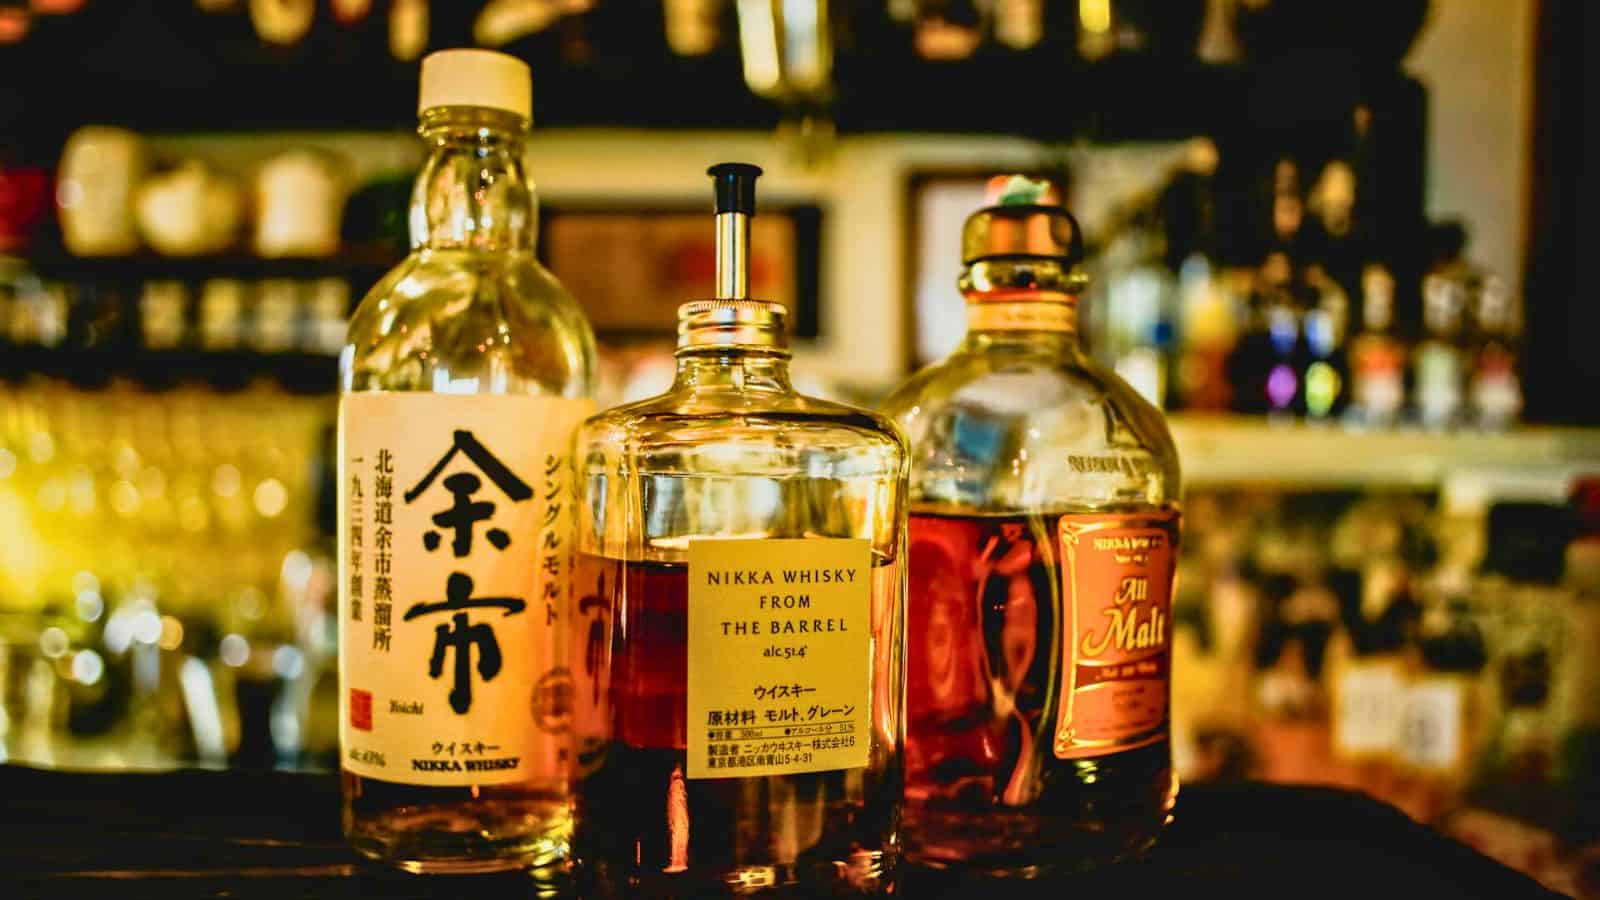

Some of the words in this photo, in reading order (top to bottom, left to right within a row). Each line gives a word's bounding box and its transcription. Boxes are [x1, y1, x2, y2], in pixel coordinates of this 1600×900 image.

[543, 455, 562, 626] シングルモルト
[404, 430, 534, 715] 余市
[707, 571, 774, 585] NIKKA
[783, 569, 857, 584] WHISKY
[1115, 576, 1147, 604] All
[759, 595, 811, 609] FROM
[721, 621, 761, 636] THE
[770, 618, 848, 635] BARREL
[1081, 606, 1164, 656] Malt
[753, 683, 817, 701] ウイスキー
[707, 709, 756, 726] 原材料
[431, 741, 500, 756] ウイスキー
[411, 759, 462, 772] NIKKA
